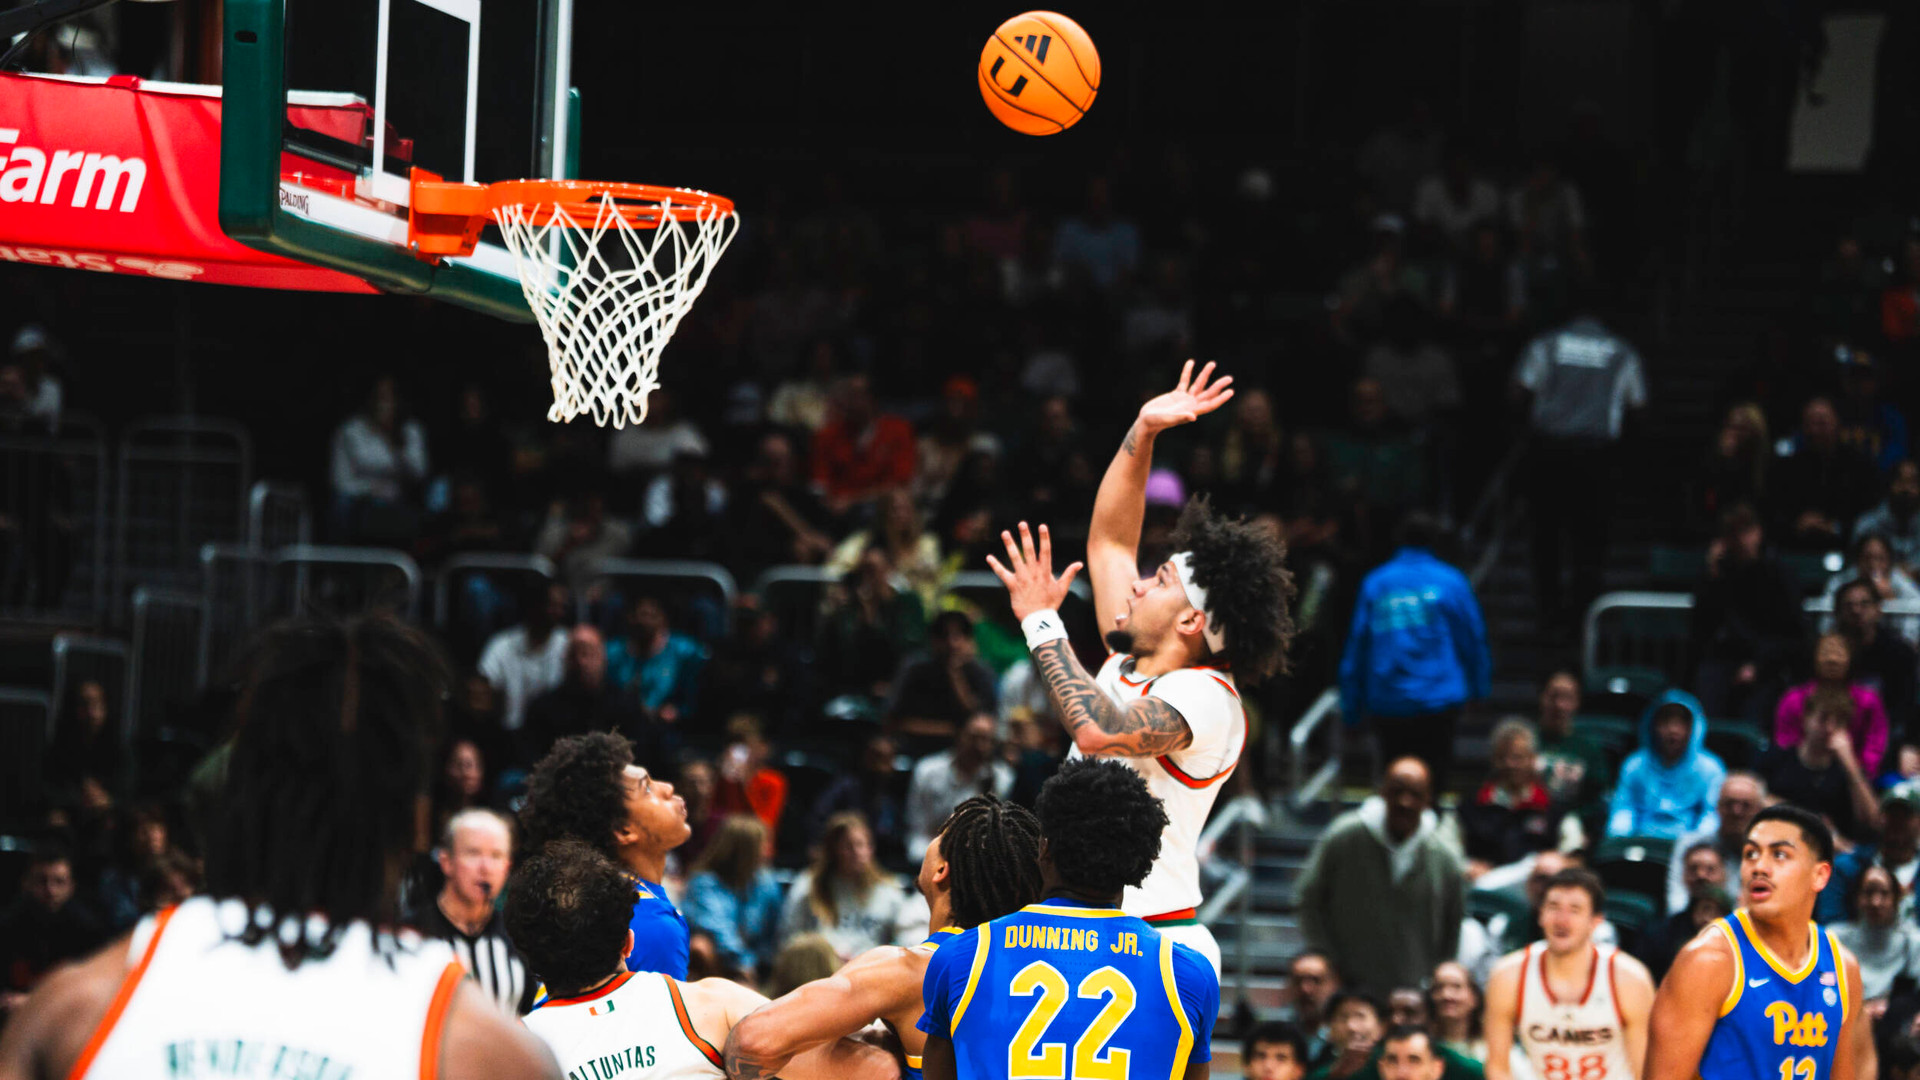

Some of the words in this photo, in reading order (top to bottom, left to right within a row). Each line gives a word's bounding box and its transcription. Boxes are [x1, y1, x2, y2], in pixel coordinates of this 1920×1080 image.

[280, 187, 309, 216] PALDING
[1004, 925, 1099, 952] DUNNING
[1110, 932, 1144, 957] JR.
[1008, 960, 1137, 1080] 22
[1528, 1025, 1614, 1042] CANES
[1764, 1000, 1829, 1047] Pitt
[1543, 1053, 1608, 1080] 88
